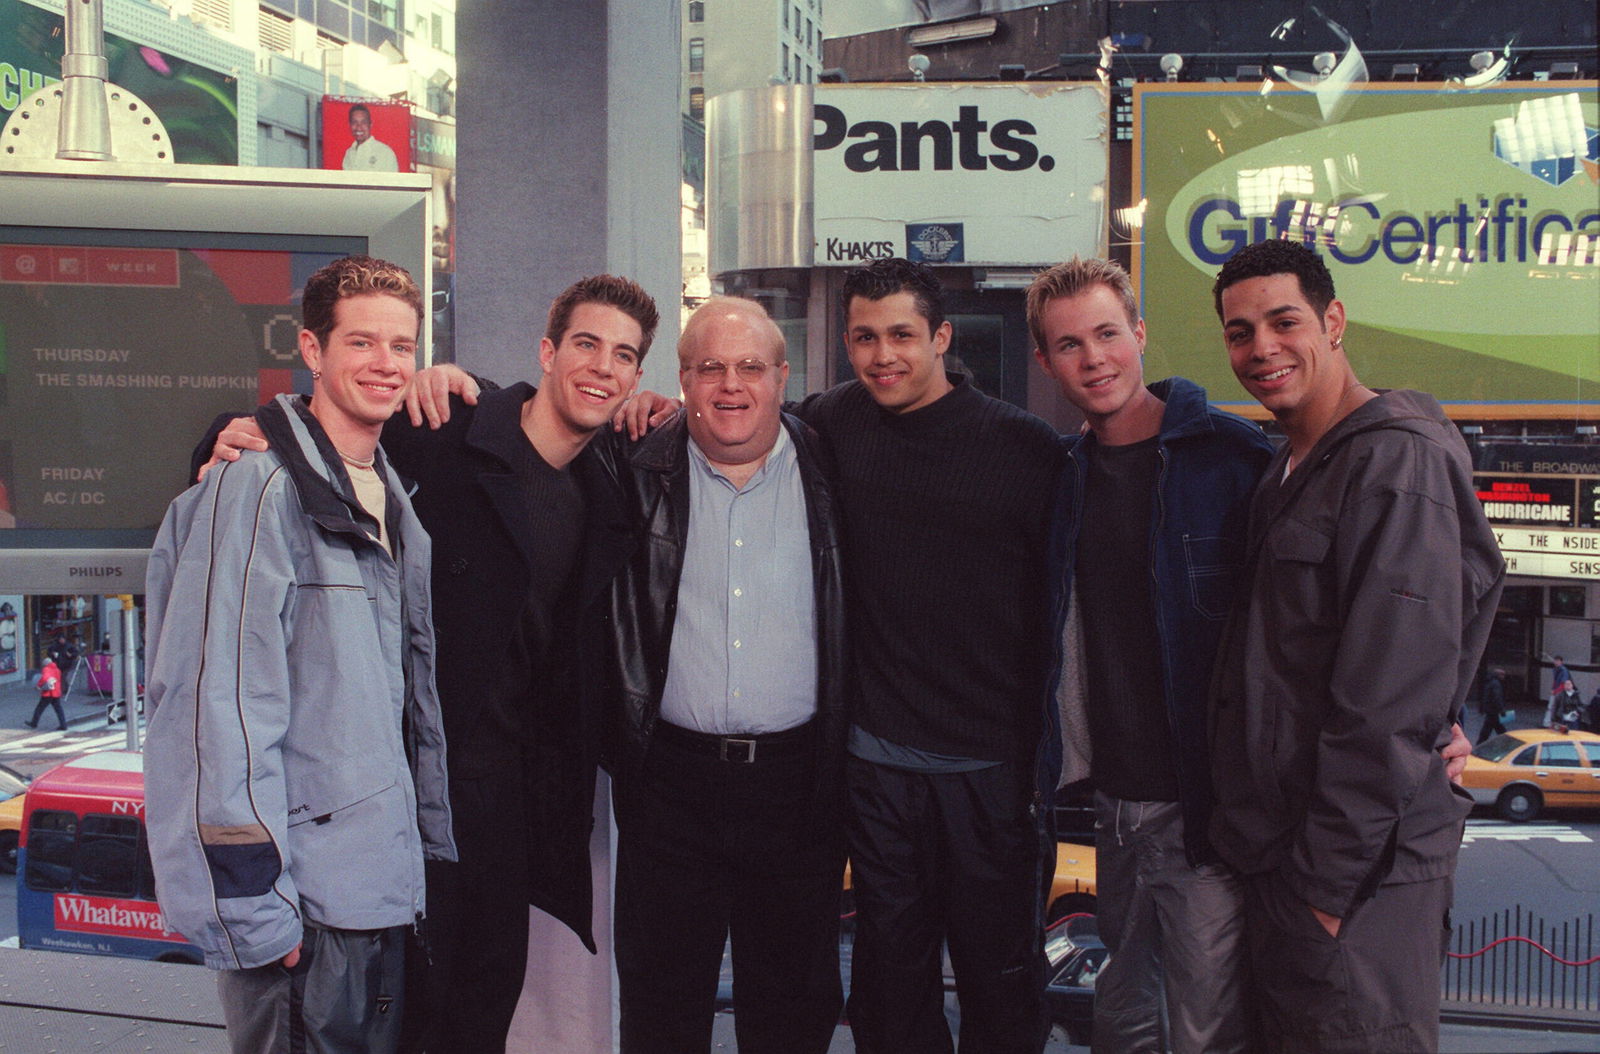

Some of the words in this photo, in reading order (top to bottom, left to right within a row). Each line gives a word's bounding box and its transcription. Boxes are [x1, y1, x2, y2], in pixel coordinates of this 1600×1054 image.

[0, 62, 62, 111] CH
[814, 104, 1056, 173] Pants.
[827, 238, 894, 261] KHAKIS
[33, 349, 129, 363] THURSDAY
[36, 373, 70, 386] THE
[77, 374, 172, 388] SMASHING
[179, 375, 258, 388] PUMPKIN
[41, 467, 105, 480] FRIDAY
[1500, 461, 1524, 472] THE
[43, 491, 67, 504] AC
[81, 492, 105, 504] DC
[1484, 502, 1571, 521] HURRICANE
[1529, 534, 1548, 547] THE
[1563, 536, 1598, 550] NSIDE
[69, 567, 122, 577] PHILIPS
[1570, 561, 1600, 575] SENS
[112, 800, 145, 815] NY
